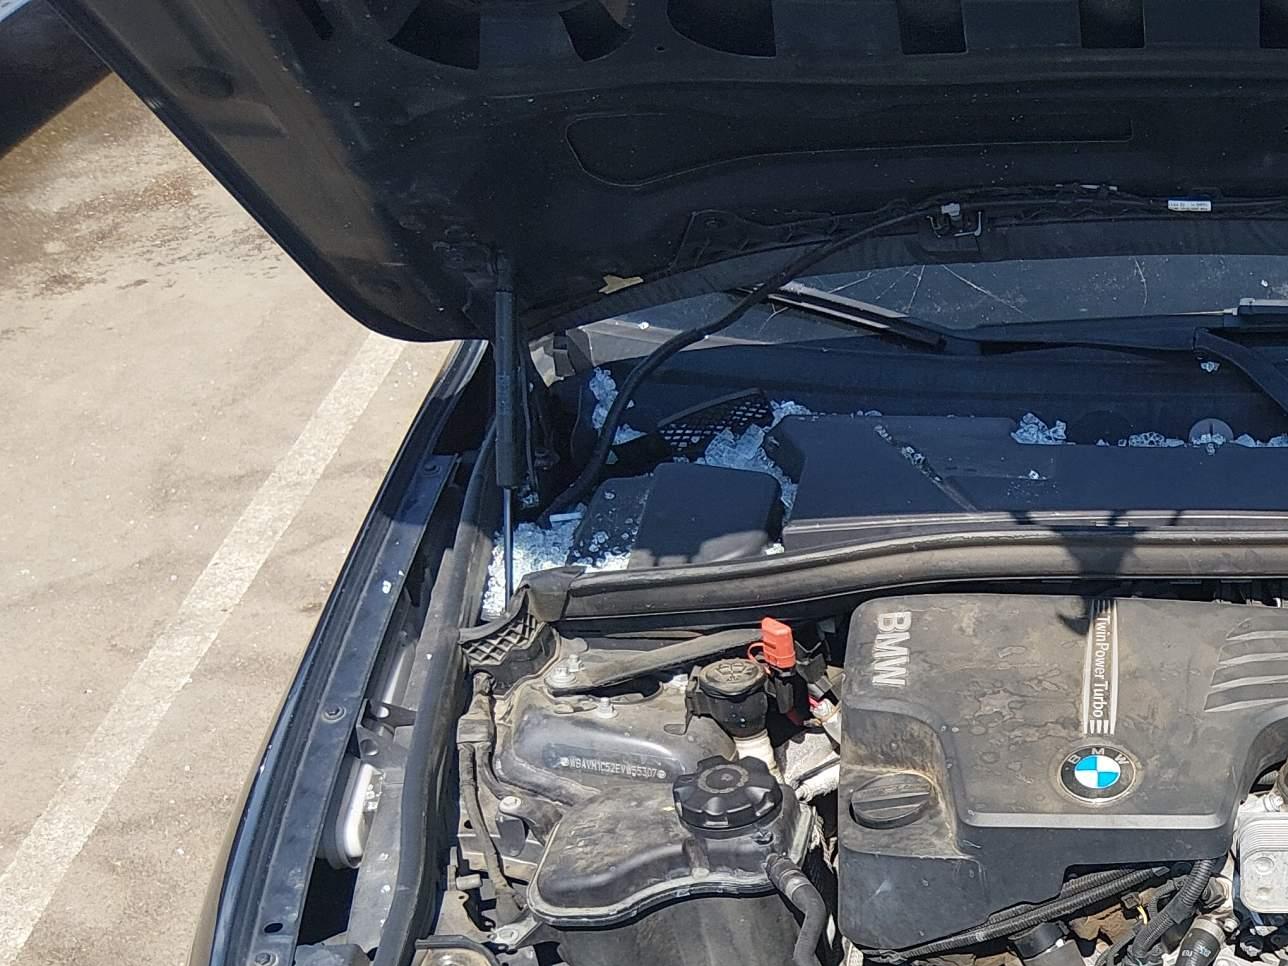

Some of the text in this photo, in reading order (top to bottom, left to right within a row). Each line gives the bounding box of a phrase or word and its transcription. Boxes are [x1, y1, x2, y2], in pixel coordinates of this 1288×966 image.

[872, 611, 912, 687] BMW
[1092, 615, 1111, 718] TwinPower Turbo
[1068, 747, 1129, 766] BMW
